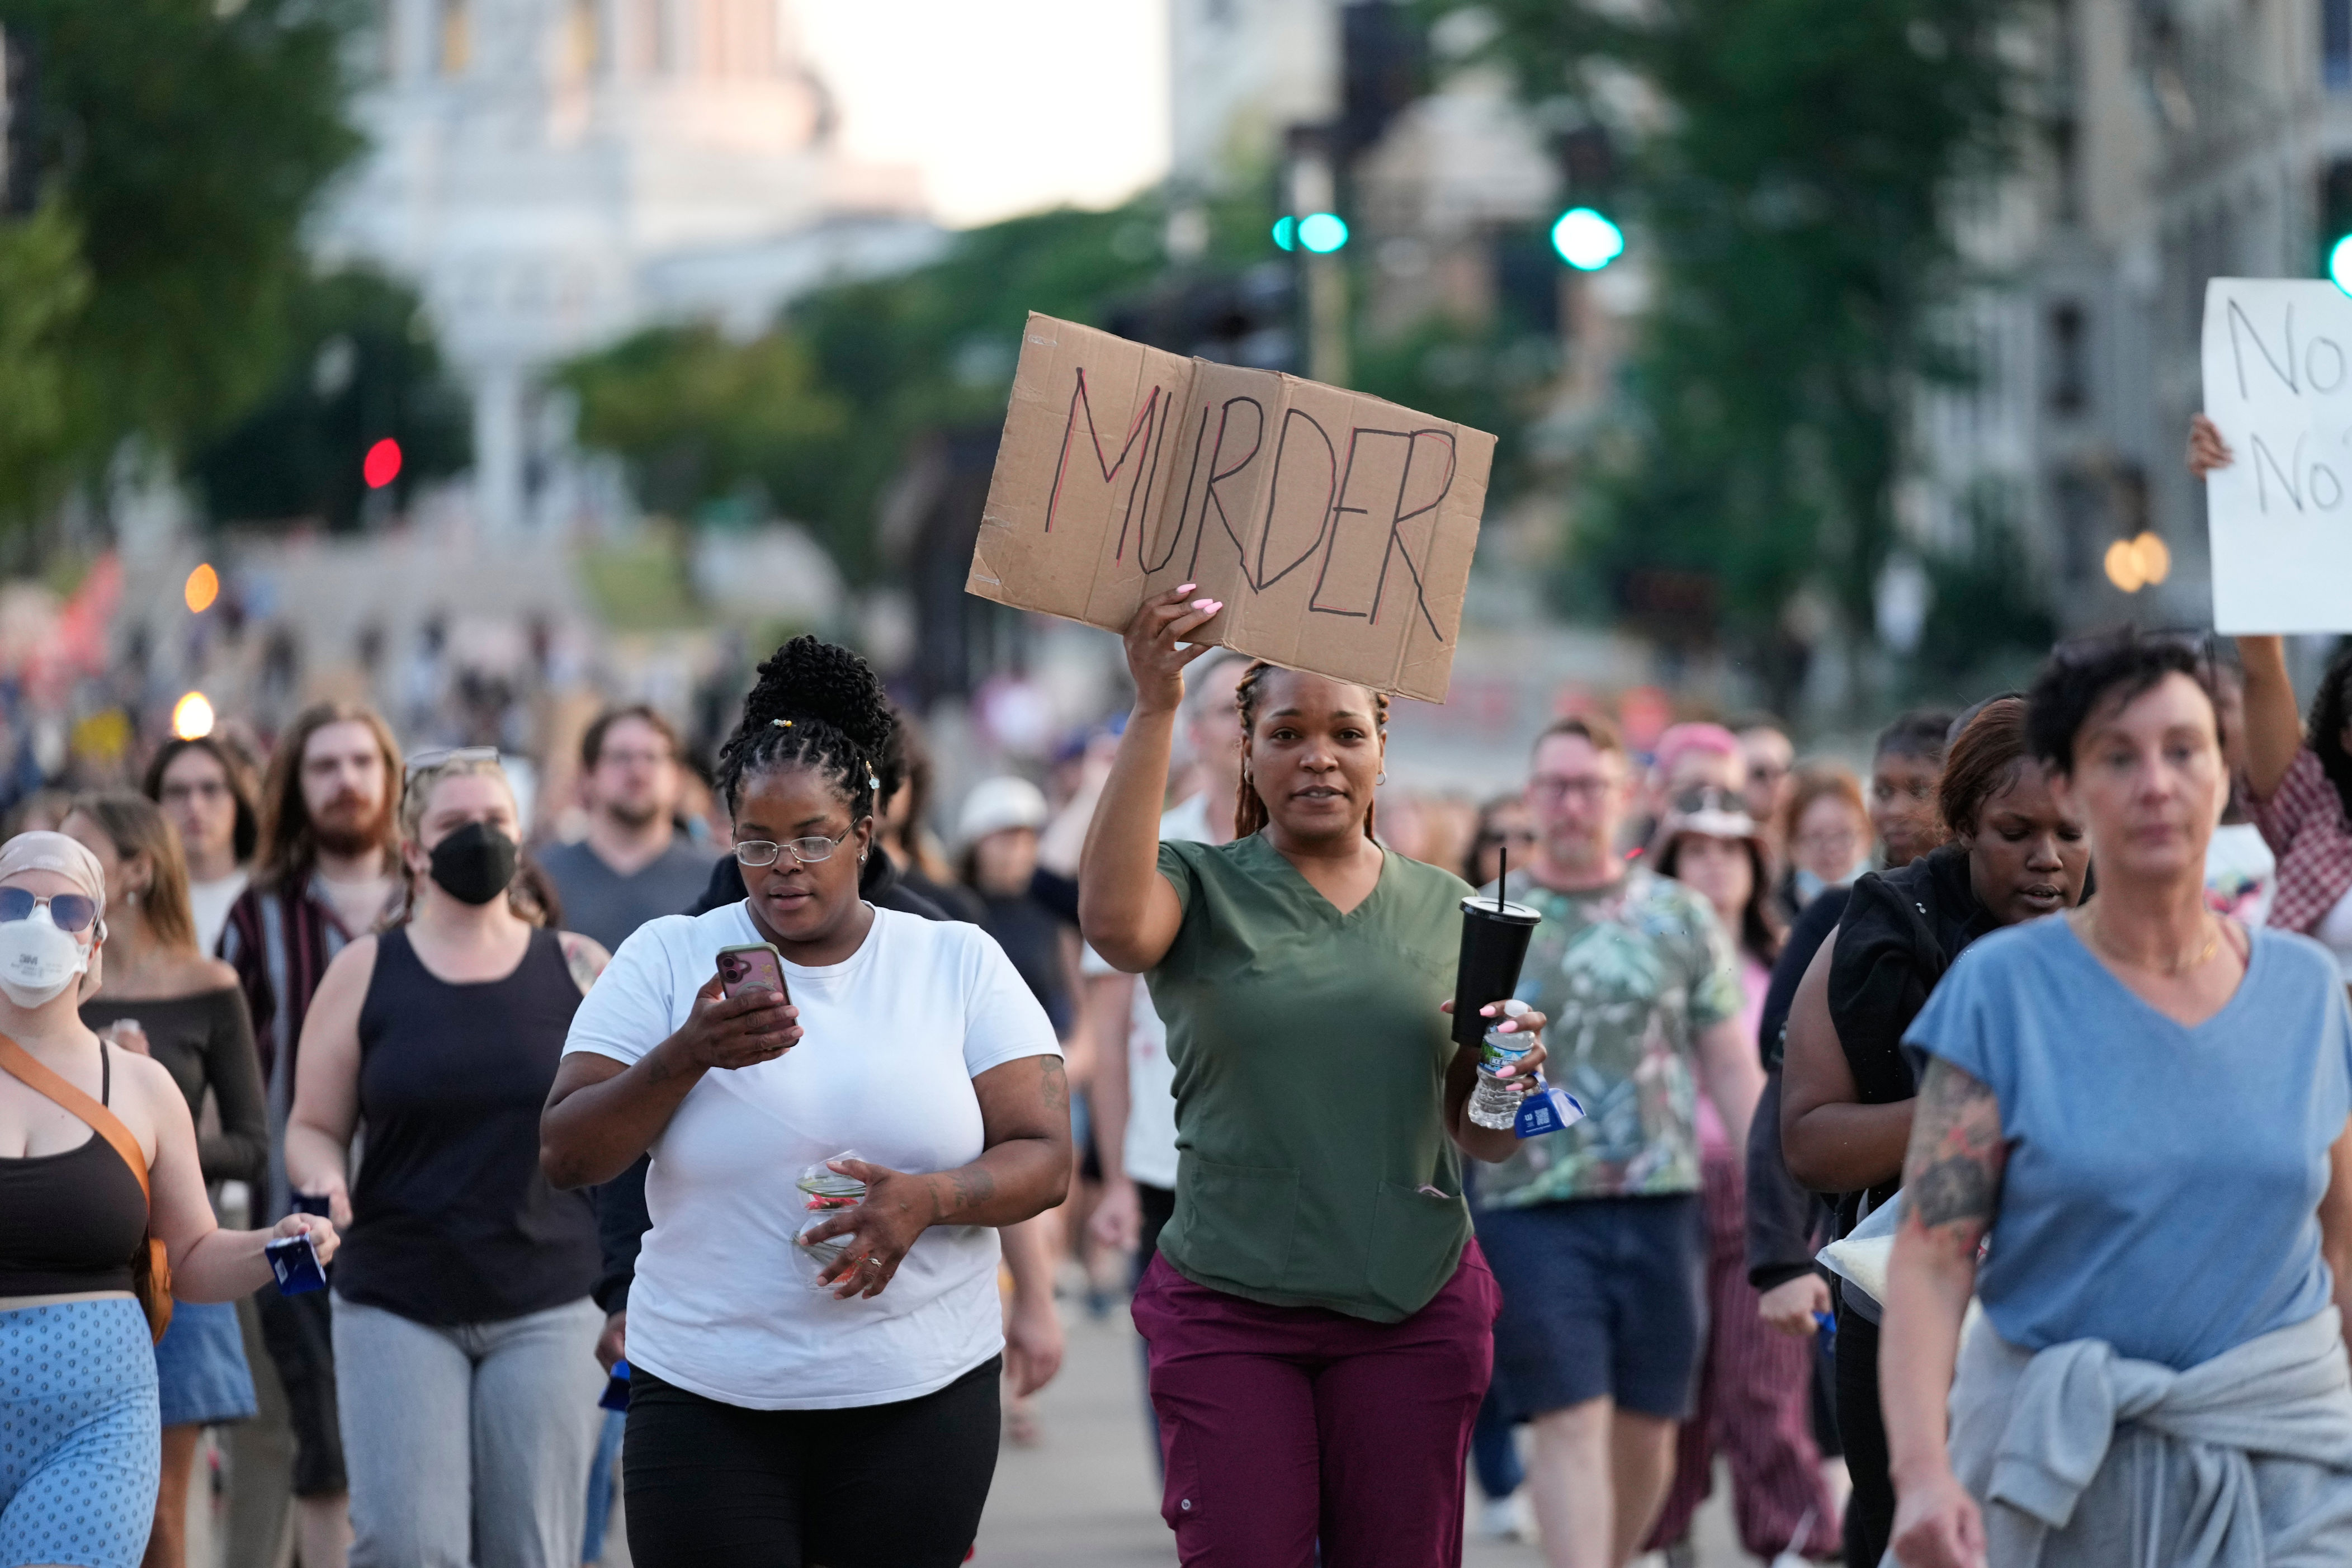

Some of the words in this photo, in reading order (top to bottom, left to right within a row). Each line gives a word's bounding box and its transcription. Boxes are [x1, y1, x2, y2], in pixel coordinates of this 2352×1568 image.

[2227, 295, 2348, 402] No
[1044, 366, 1457, 645] MURDER
[2250, 432, 2343, 514] No
